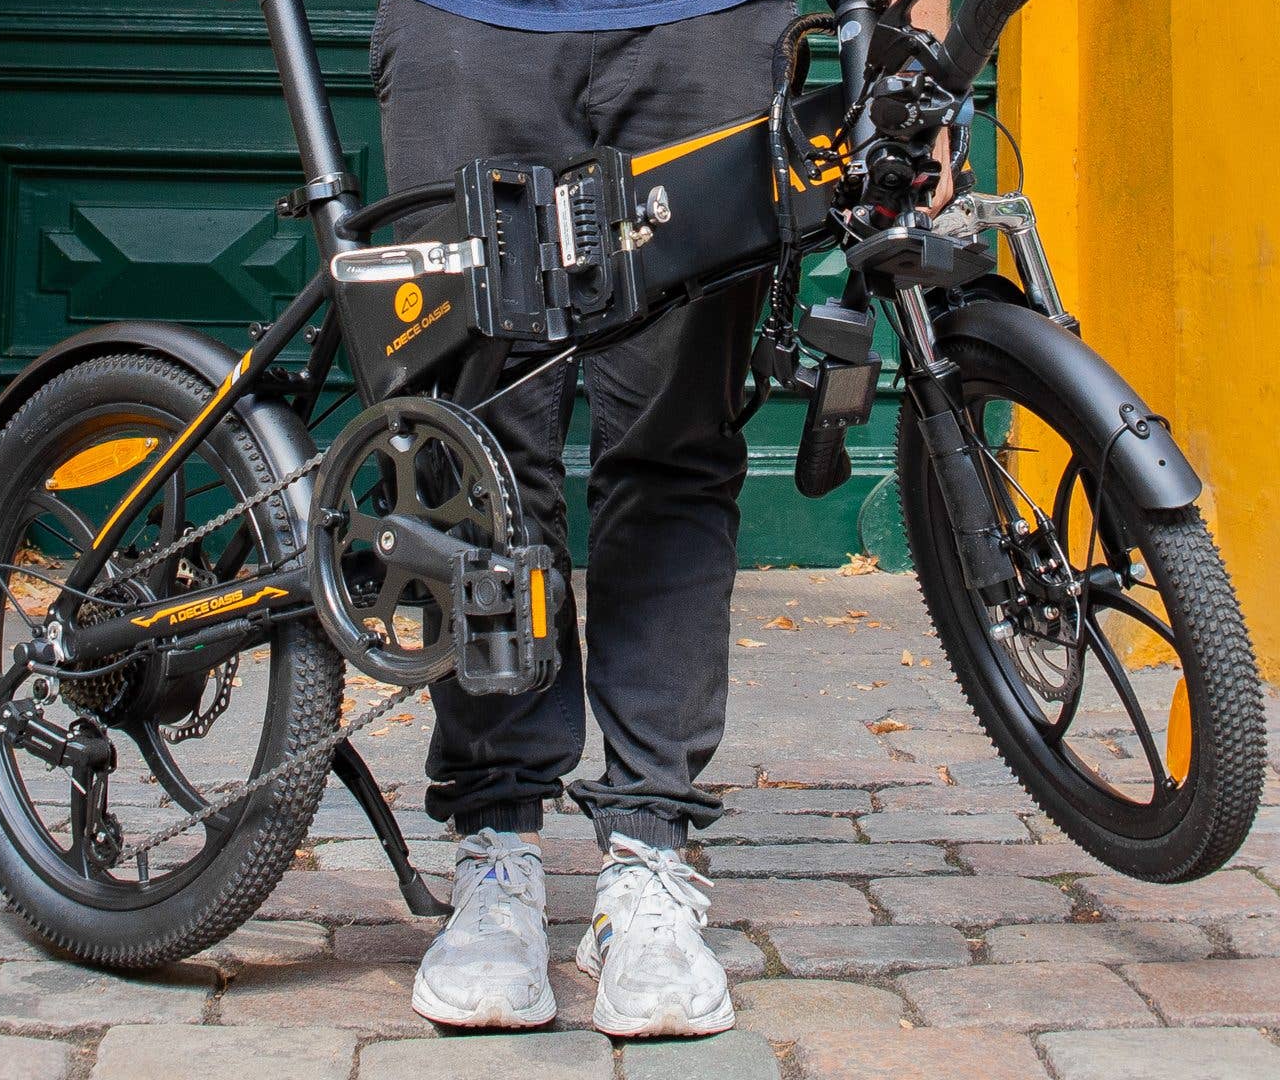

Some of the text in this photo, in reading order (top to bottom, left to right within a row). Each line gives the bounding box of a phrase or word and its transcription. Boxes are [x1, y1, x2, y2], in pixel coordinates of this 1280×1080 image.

[385, 301, 452, 357] A DECE OASIS
[169, 589, 244, 625] A DECE OASIS
